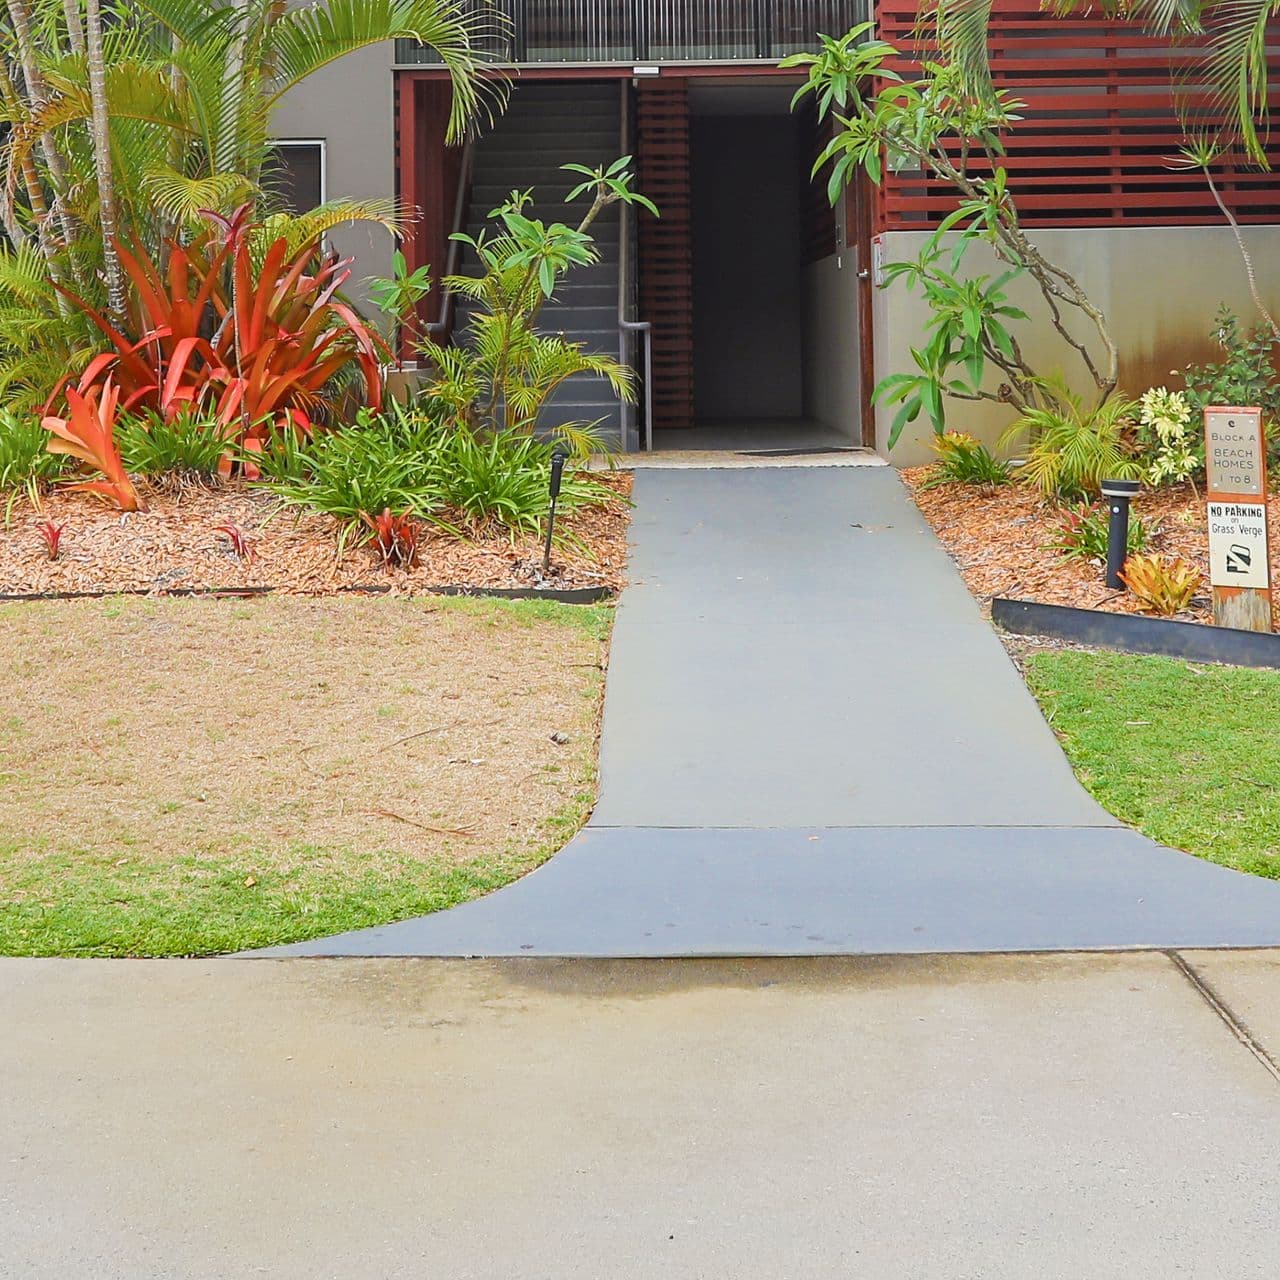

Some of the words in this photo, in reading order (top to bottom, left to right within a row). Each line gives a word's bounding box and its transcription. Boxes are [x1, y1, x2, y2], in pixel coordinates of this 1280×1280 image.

[1249, 434, 1256, 442] A
[1214, 448, 1253, 458] BEACH
[1213, 459, 1254, 469] HOMES
[1244, 475, 1251, 484] 8
[1210, 506, 1222, 517] NO
[1225, 505, 1262, 518] PARKING
[1211, 523, 1235, 535] Grass
[1238, 524, 1263, 538] Verge
